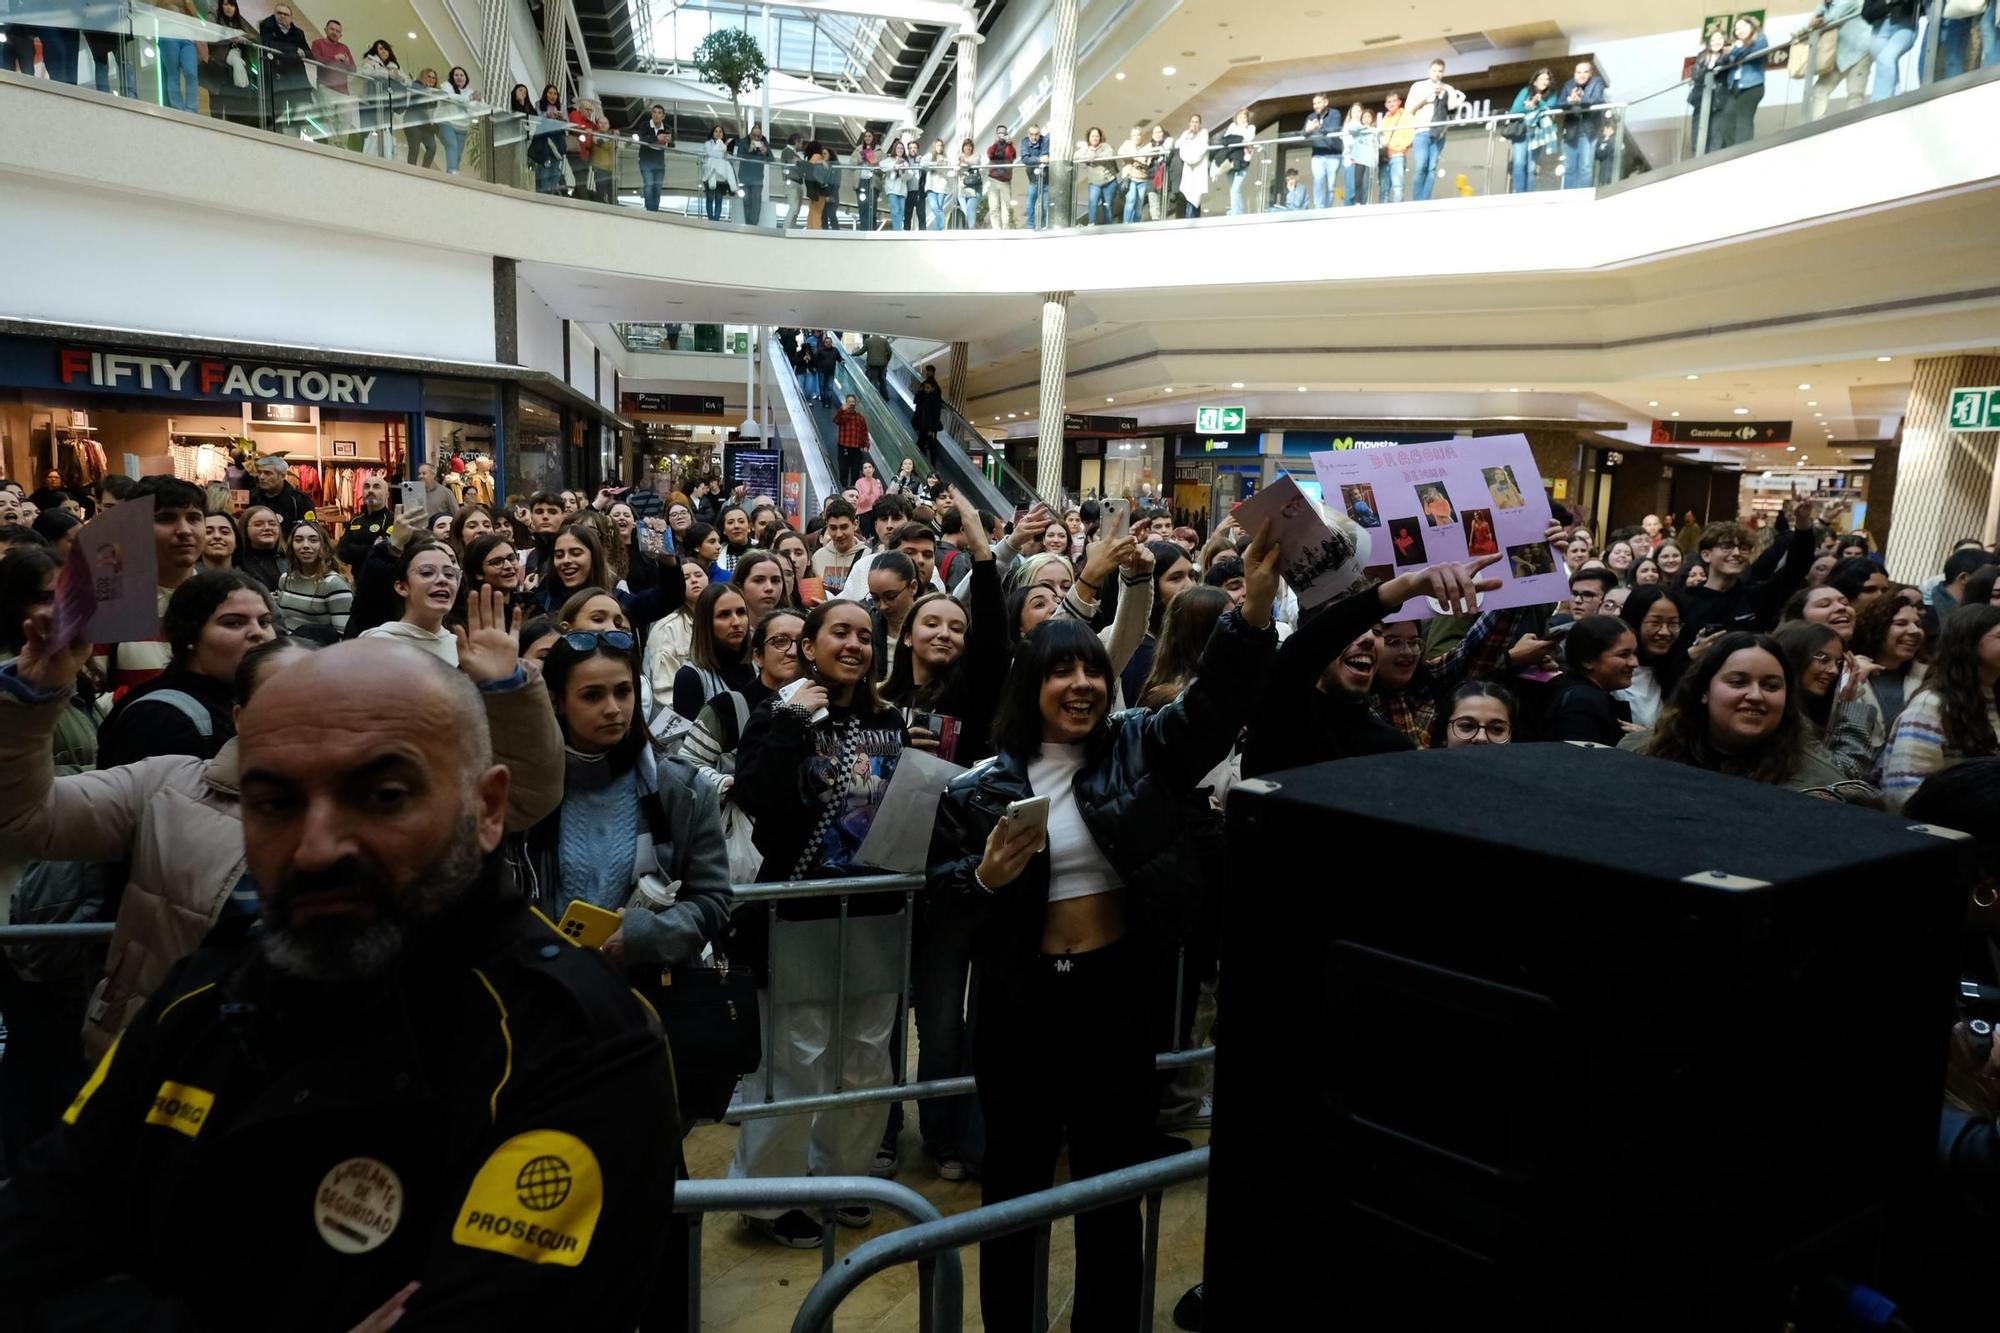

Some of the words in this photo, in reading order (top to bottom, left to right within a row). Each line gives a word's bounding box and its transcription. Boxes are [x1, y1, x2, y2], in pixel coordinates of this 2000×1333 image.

[61, 350, 190, 391] FIFTY
[201, 362, 376, 404] FACTORY
[1690, 429, 1733, 437] Carrefour
[333, 1161, 396, 1213] VIGILANTE
[353, 1182, 371, 1202] DE
[320, 1187, 393, 1234] SEGURIDAD
[466, 1211, 578, 1252] PROSEGUR
